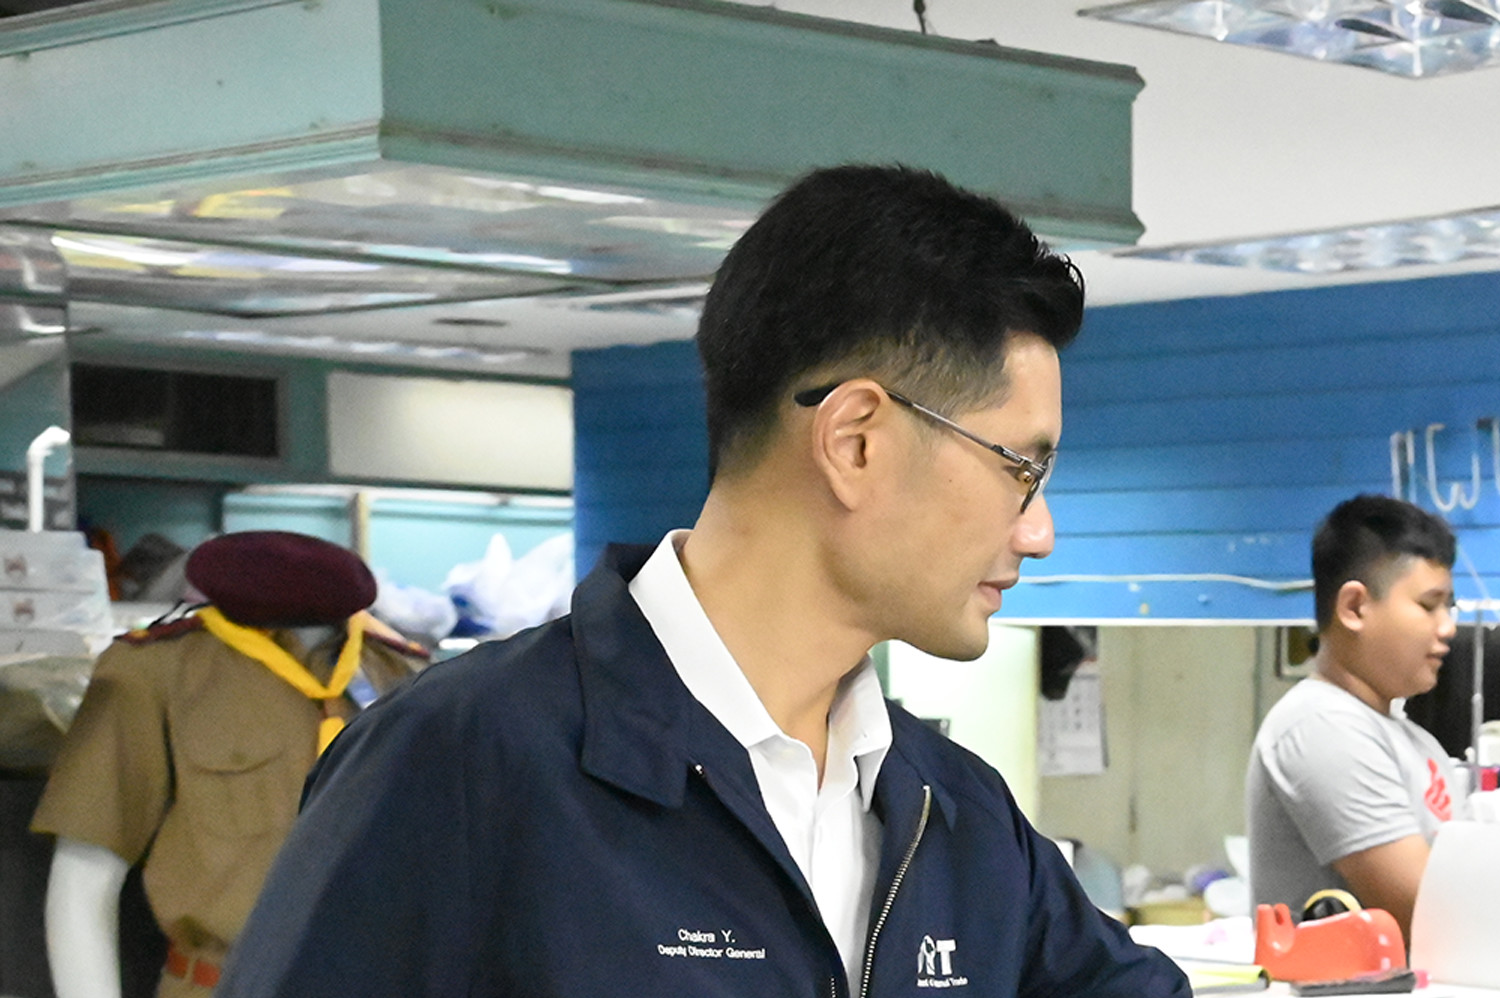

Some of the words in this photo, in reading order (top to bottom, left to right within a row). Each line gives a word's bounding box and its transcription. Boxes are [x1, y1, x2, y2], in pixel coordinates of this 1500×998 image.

[677, 928, 716, 943] Chakra
[720, 929, 736, 943] Y.
[657, 944, 687, 957] Deputy
[687, 945, 723, 958] Director
[725, 947, 766, 959] General
